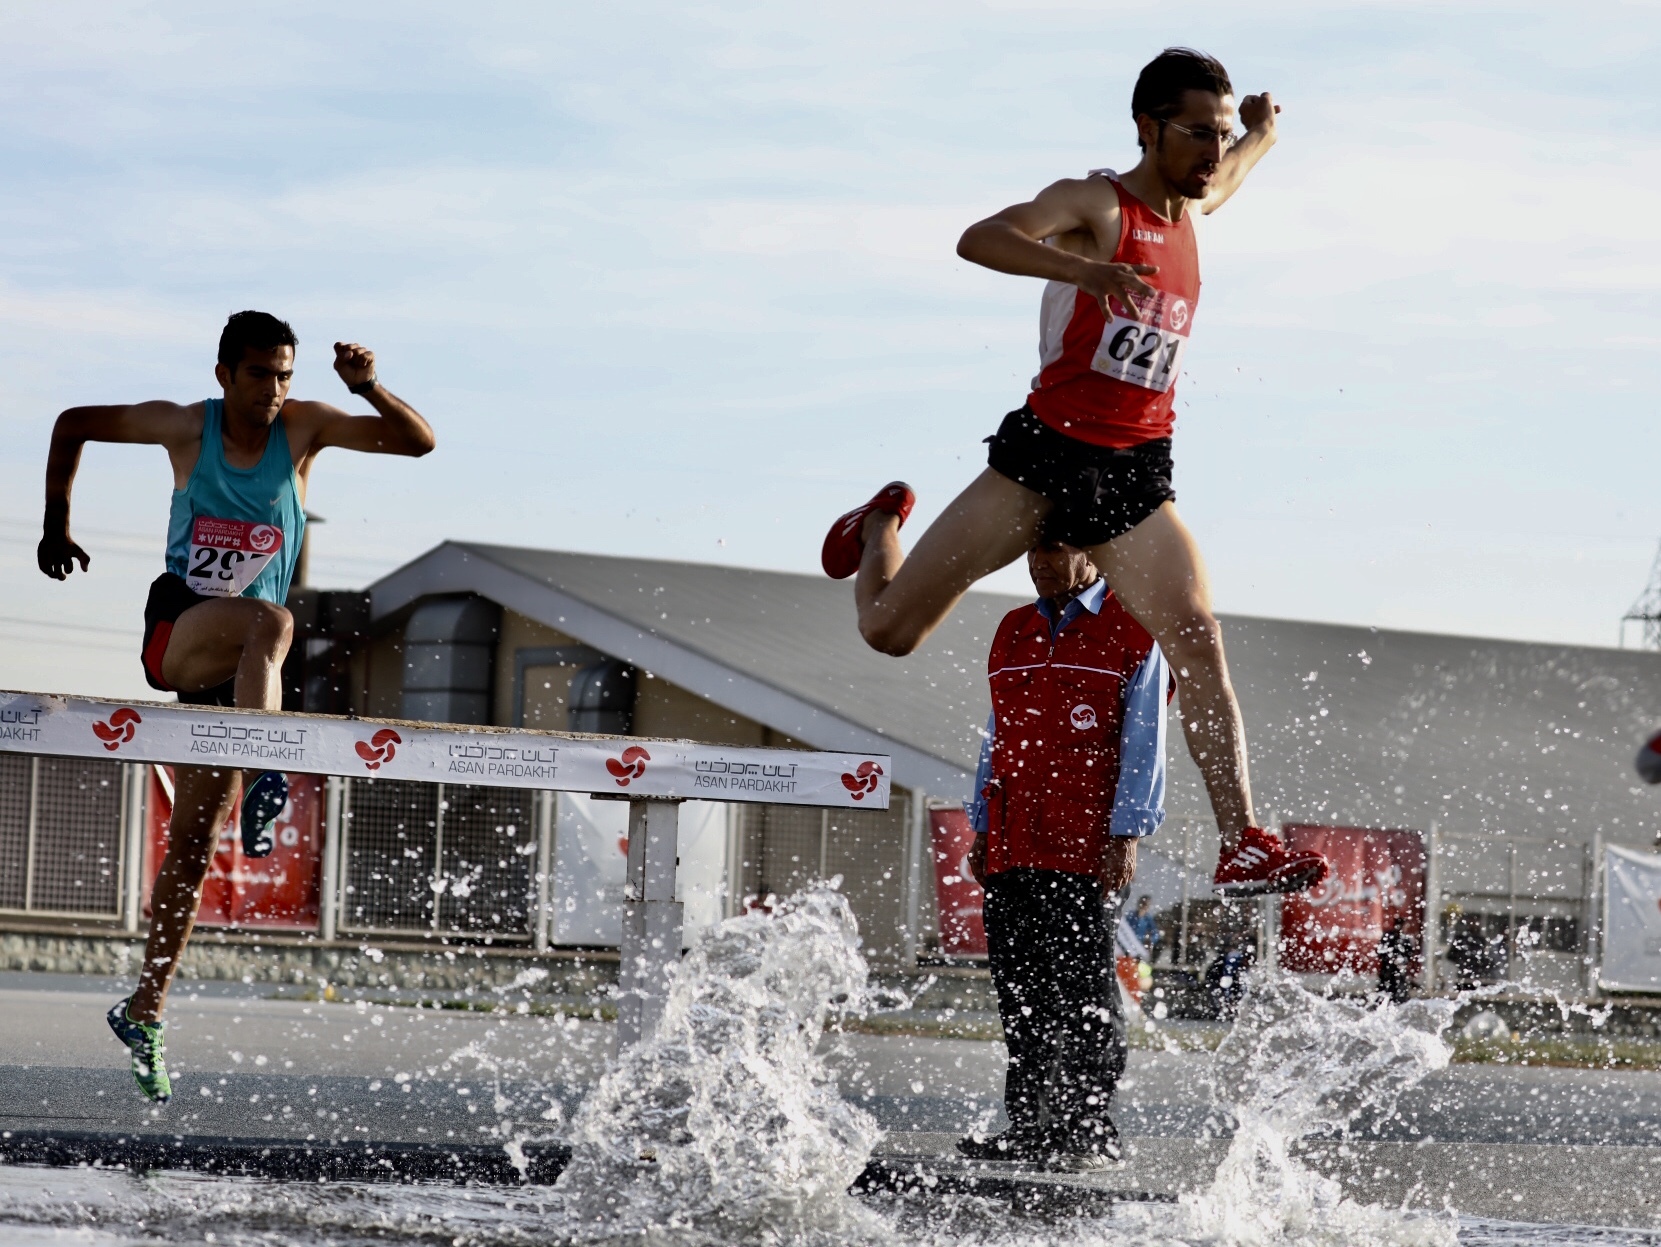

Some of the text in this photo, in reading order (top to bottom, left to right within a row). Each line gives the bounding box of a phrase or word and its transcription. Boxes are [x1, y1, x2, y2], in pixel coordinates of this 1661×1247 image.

[1108, 325, 1180, 374] 621
[190, 739, 306, 761] ASAN PARDAKHT
[448, 760, 559, 779] ASAN PARDAKHT
[694, 775, 798, 793] ASAN PARDAKHT
